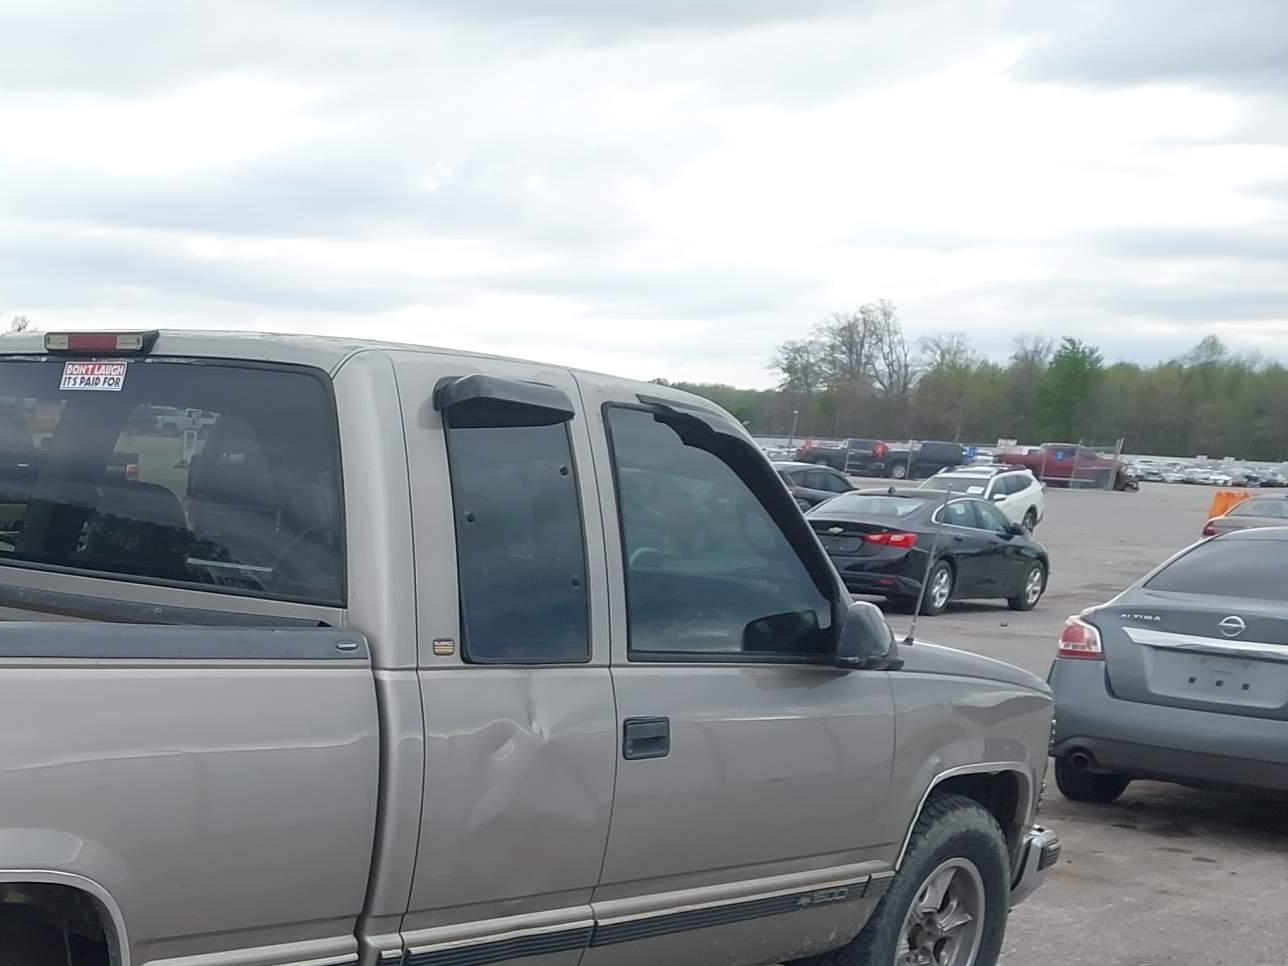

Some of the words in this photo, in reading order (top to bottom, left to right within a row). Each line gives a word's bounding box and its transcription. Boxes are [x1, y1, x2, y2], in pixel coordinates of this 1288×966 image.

[94, 364, 124, 375] LAUGH
[79, 376, 101, 387] PAID
[102, 376, 121, 388] FOR
